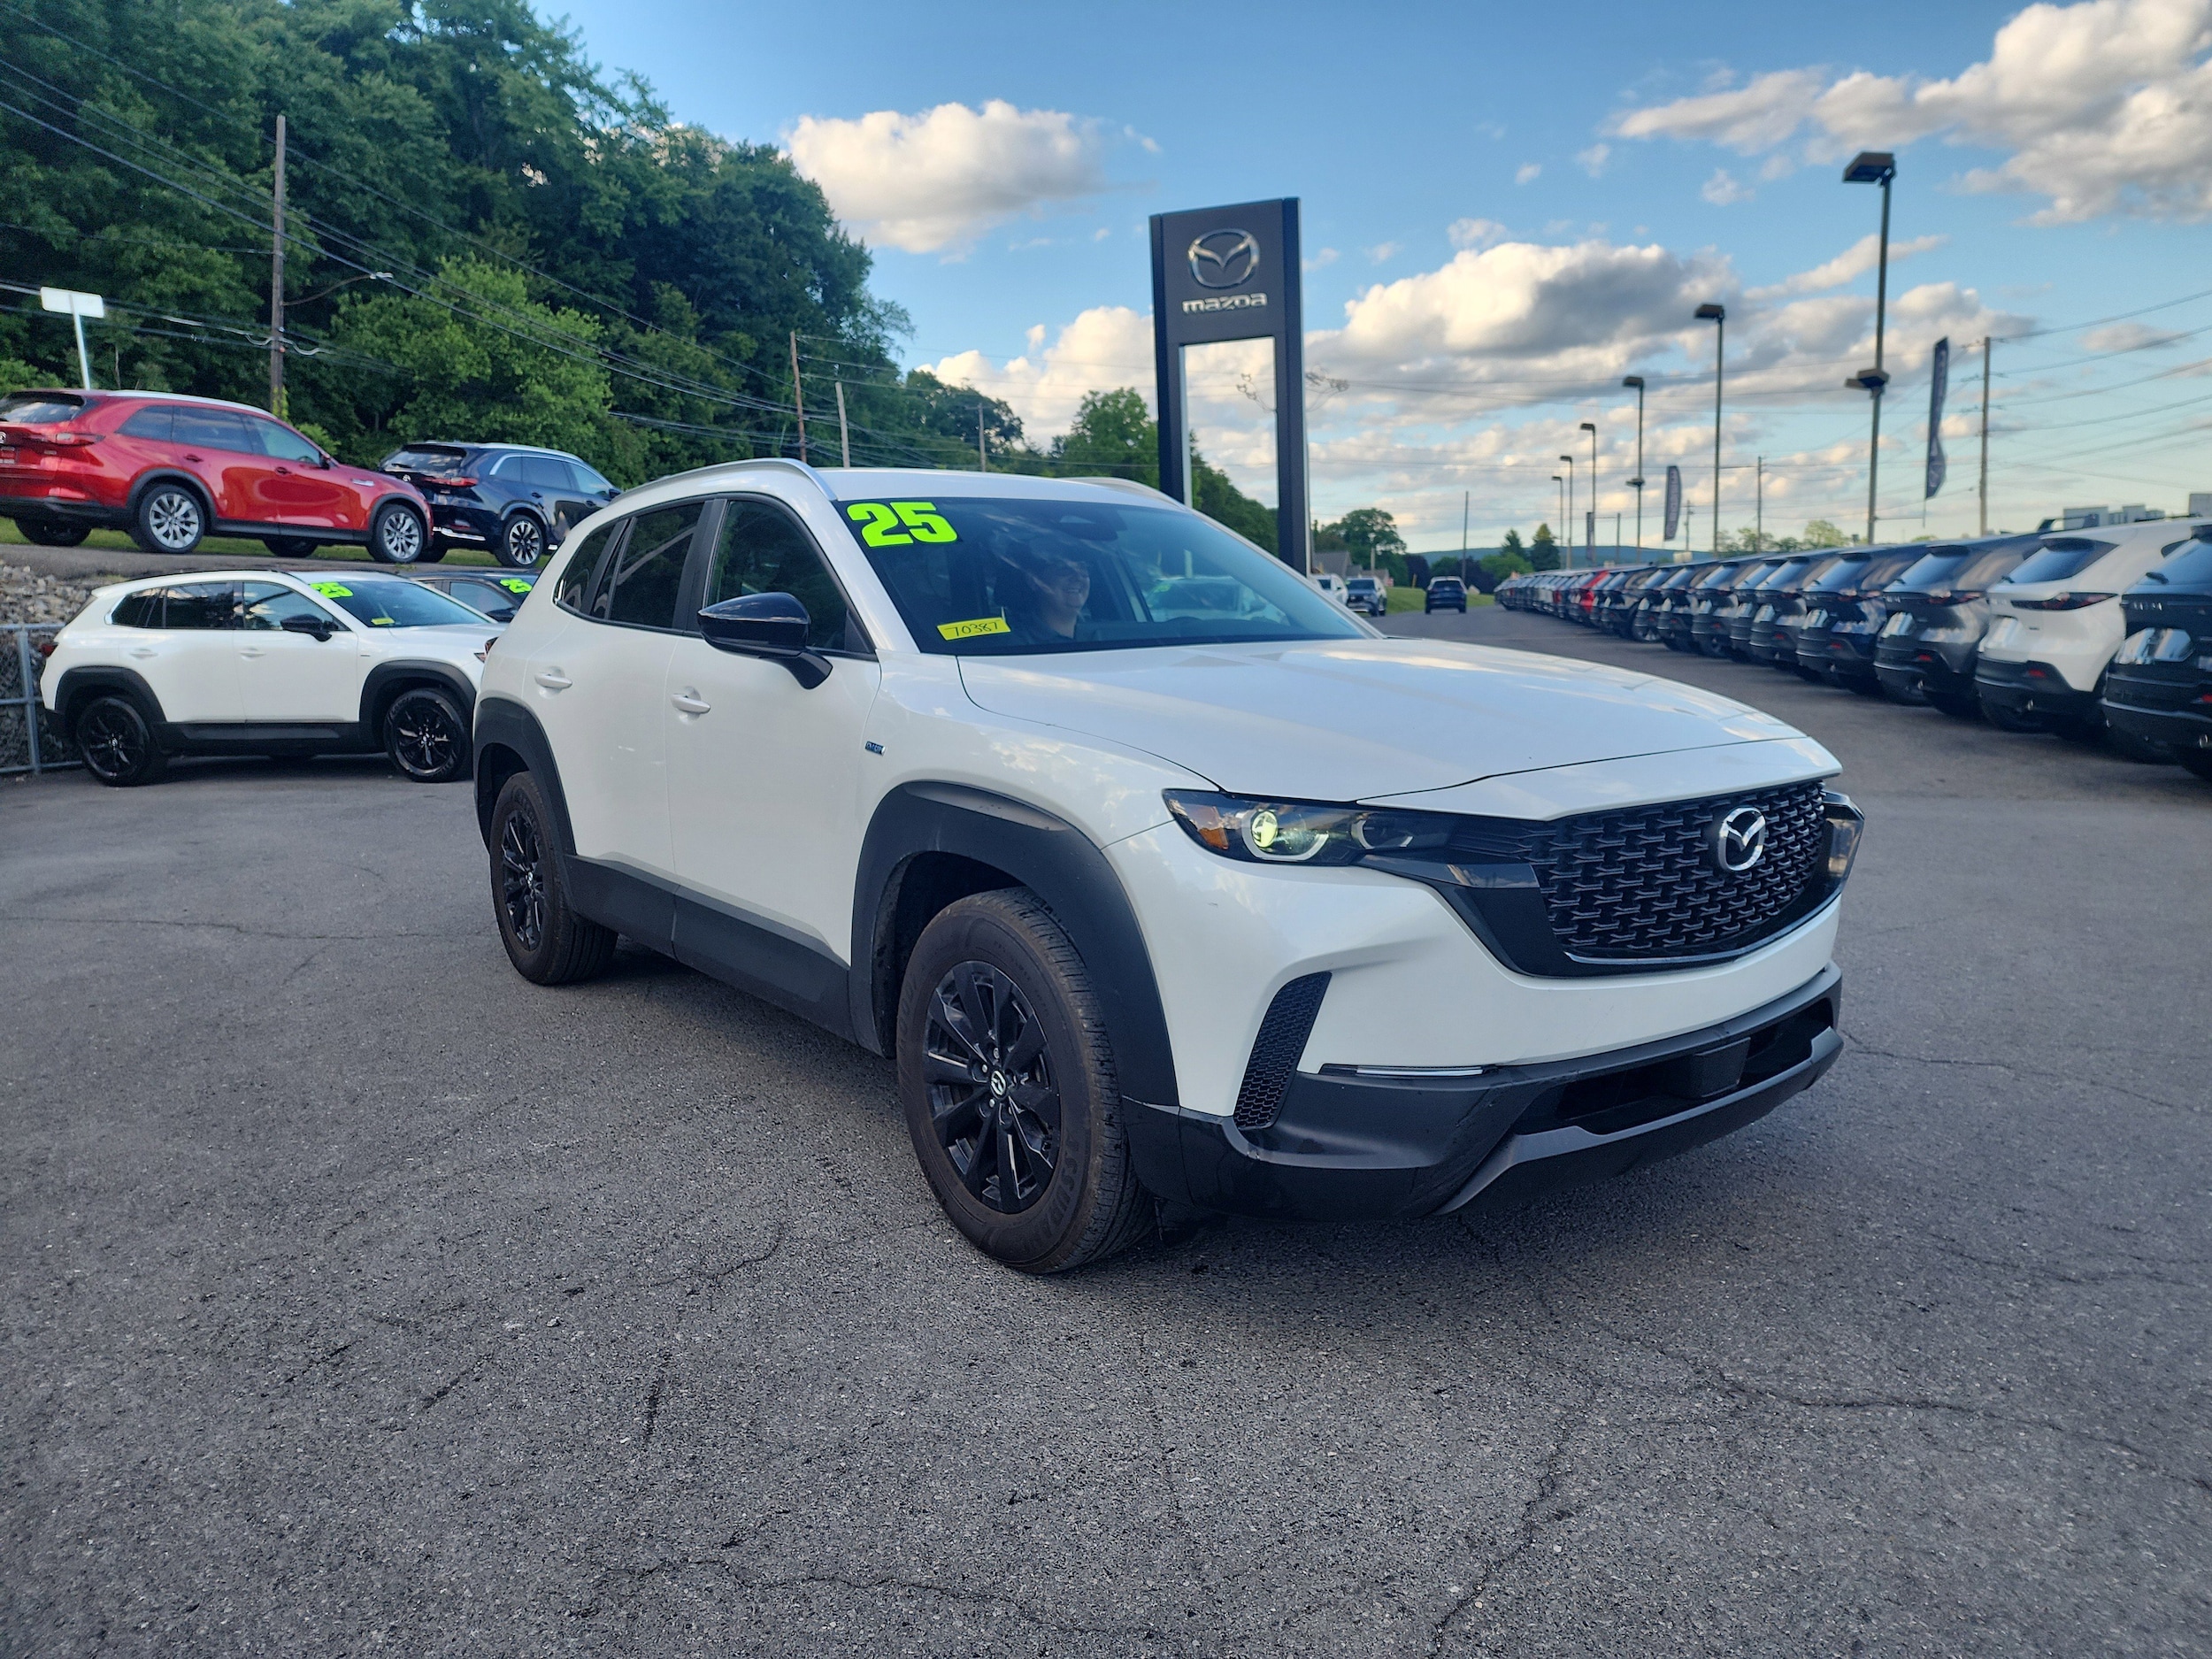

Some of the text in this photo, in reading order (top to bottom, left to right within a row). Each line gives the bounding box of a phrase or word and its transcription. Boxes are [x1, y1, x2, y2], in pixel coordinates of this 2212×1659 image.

[1182, 292, 1268, 314] mazda
[847, 502, 957, 547] 25
[944, 622, 998, 636] 70387
